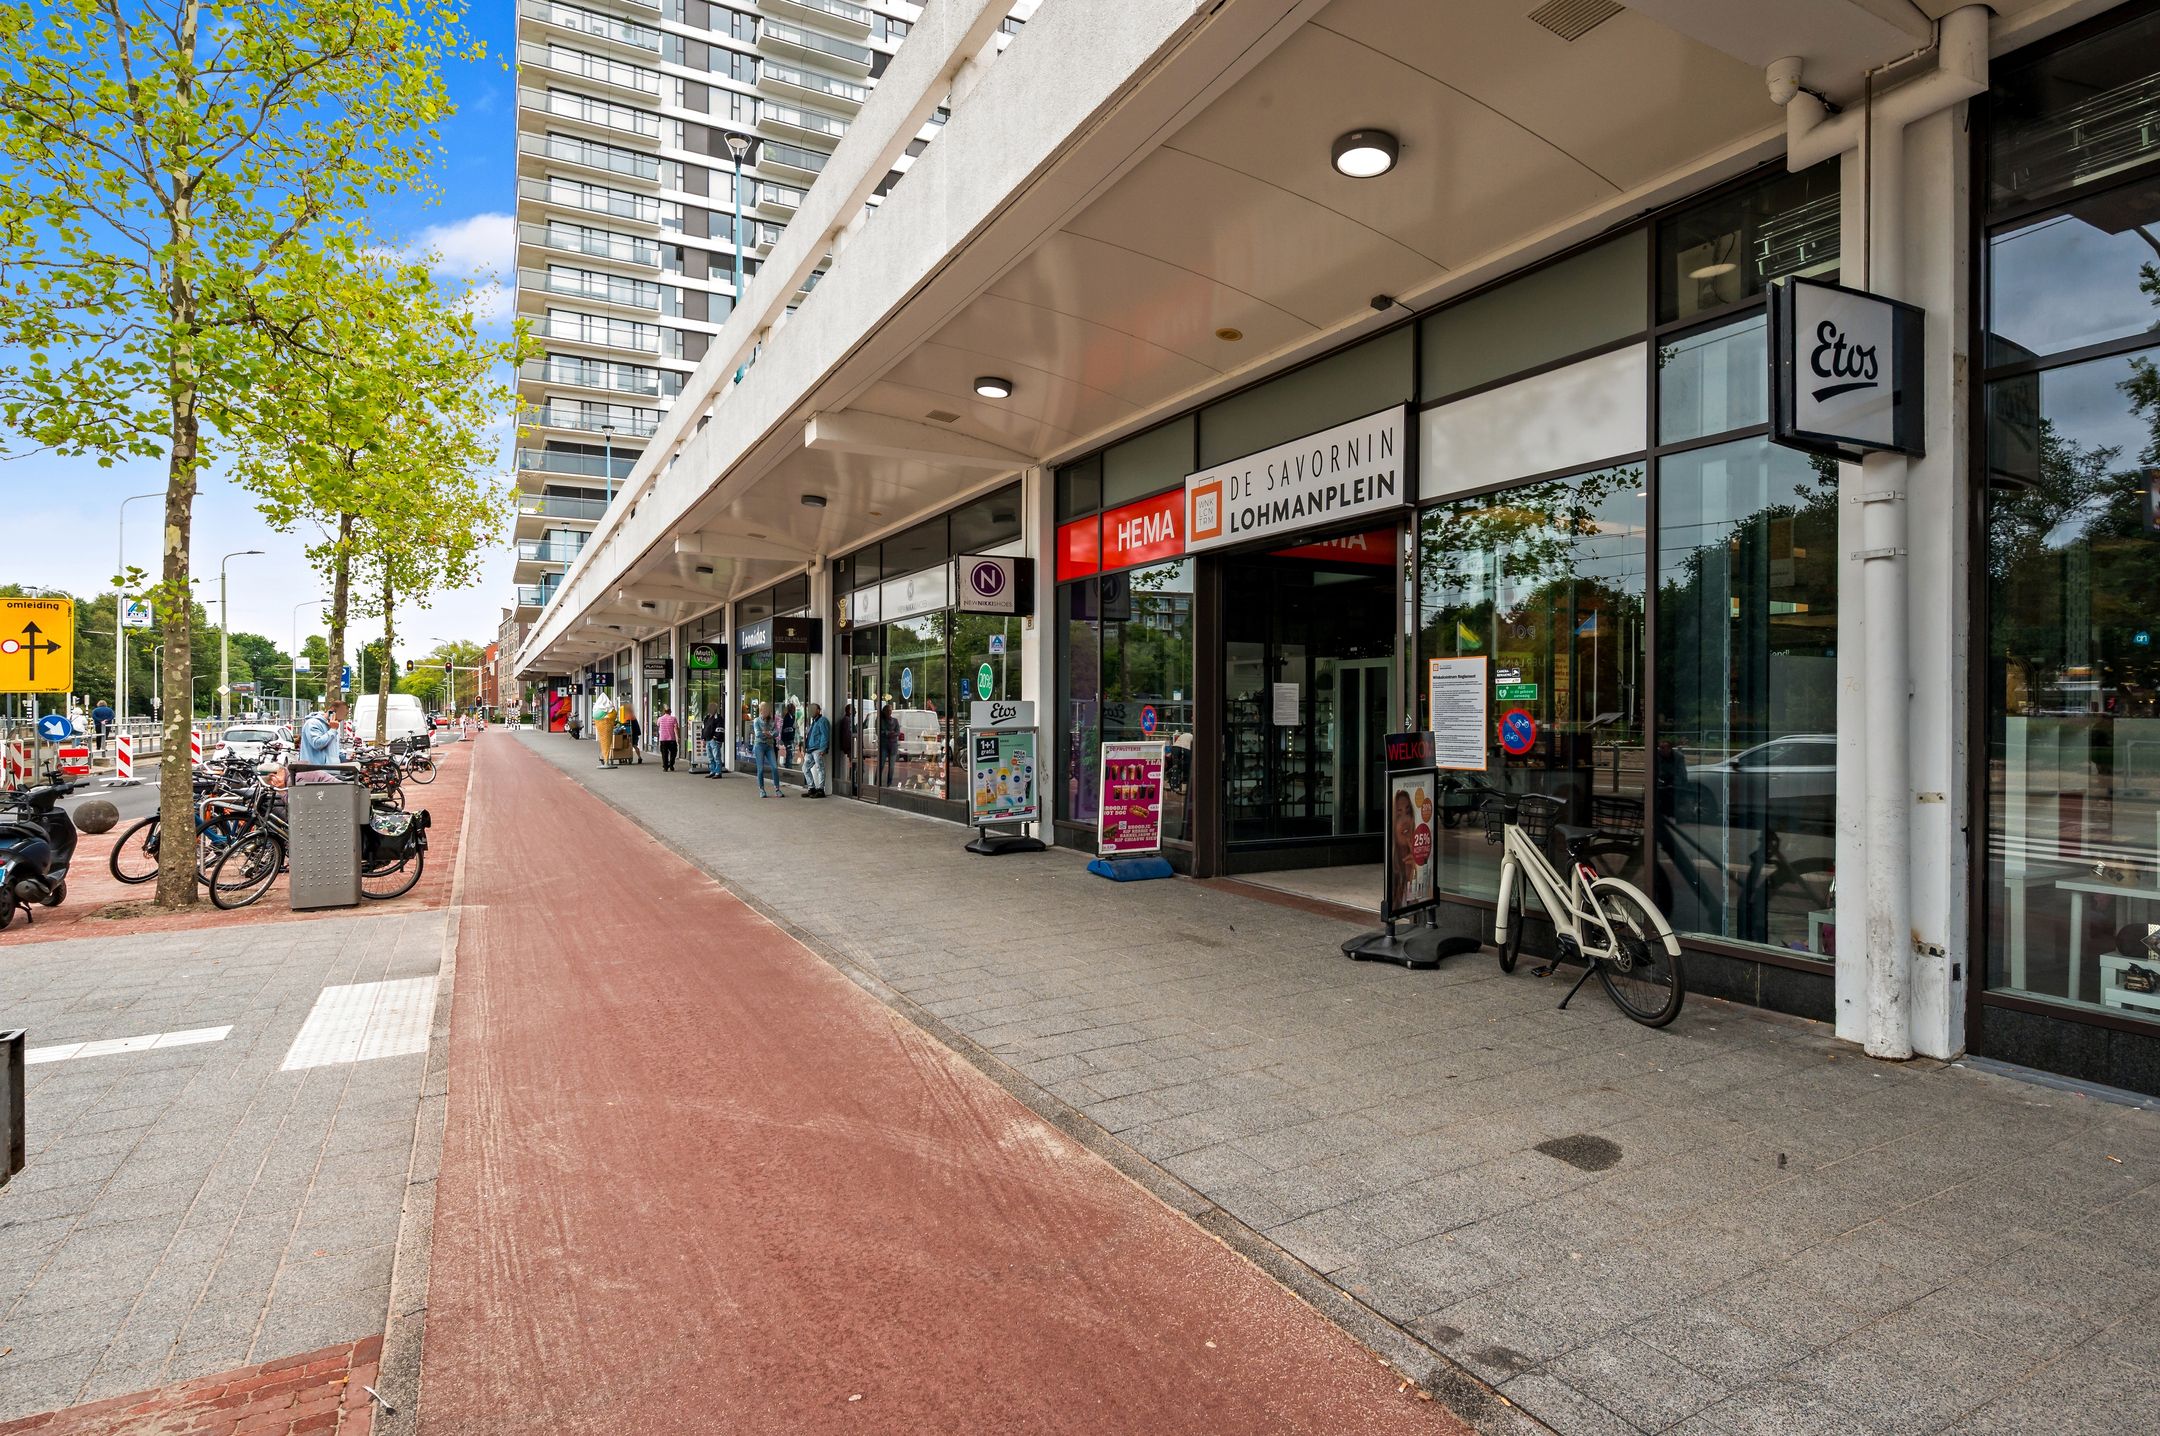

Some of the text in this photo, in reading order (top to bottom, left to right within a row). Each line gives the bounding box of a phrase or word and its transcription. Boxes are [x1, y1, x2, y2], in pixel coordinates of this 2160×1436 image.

[1810, 320, 1879, 380] Etos
[1231, 427, 1393, 501] DE SAVORNIN
[1230, 470, 1395, 533] LOHMANPLEIN
[1118, 509, 1175, 551] HEMA
[981, 569, 996, 589] N
[6, 601, 60, 611] omleiding
[741, 625, 766, 649] Leonidas
[990, 703, 1017, 719] Etos
[980, 740, 995, 750] 1+1
[980, 748, 996, 756] gratis
[1414, 833, 1431, 847] 25%
